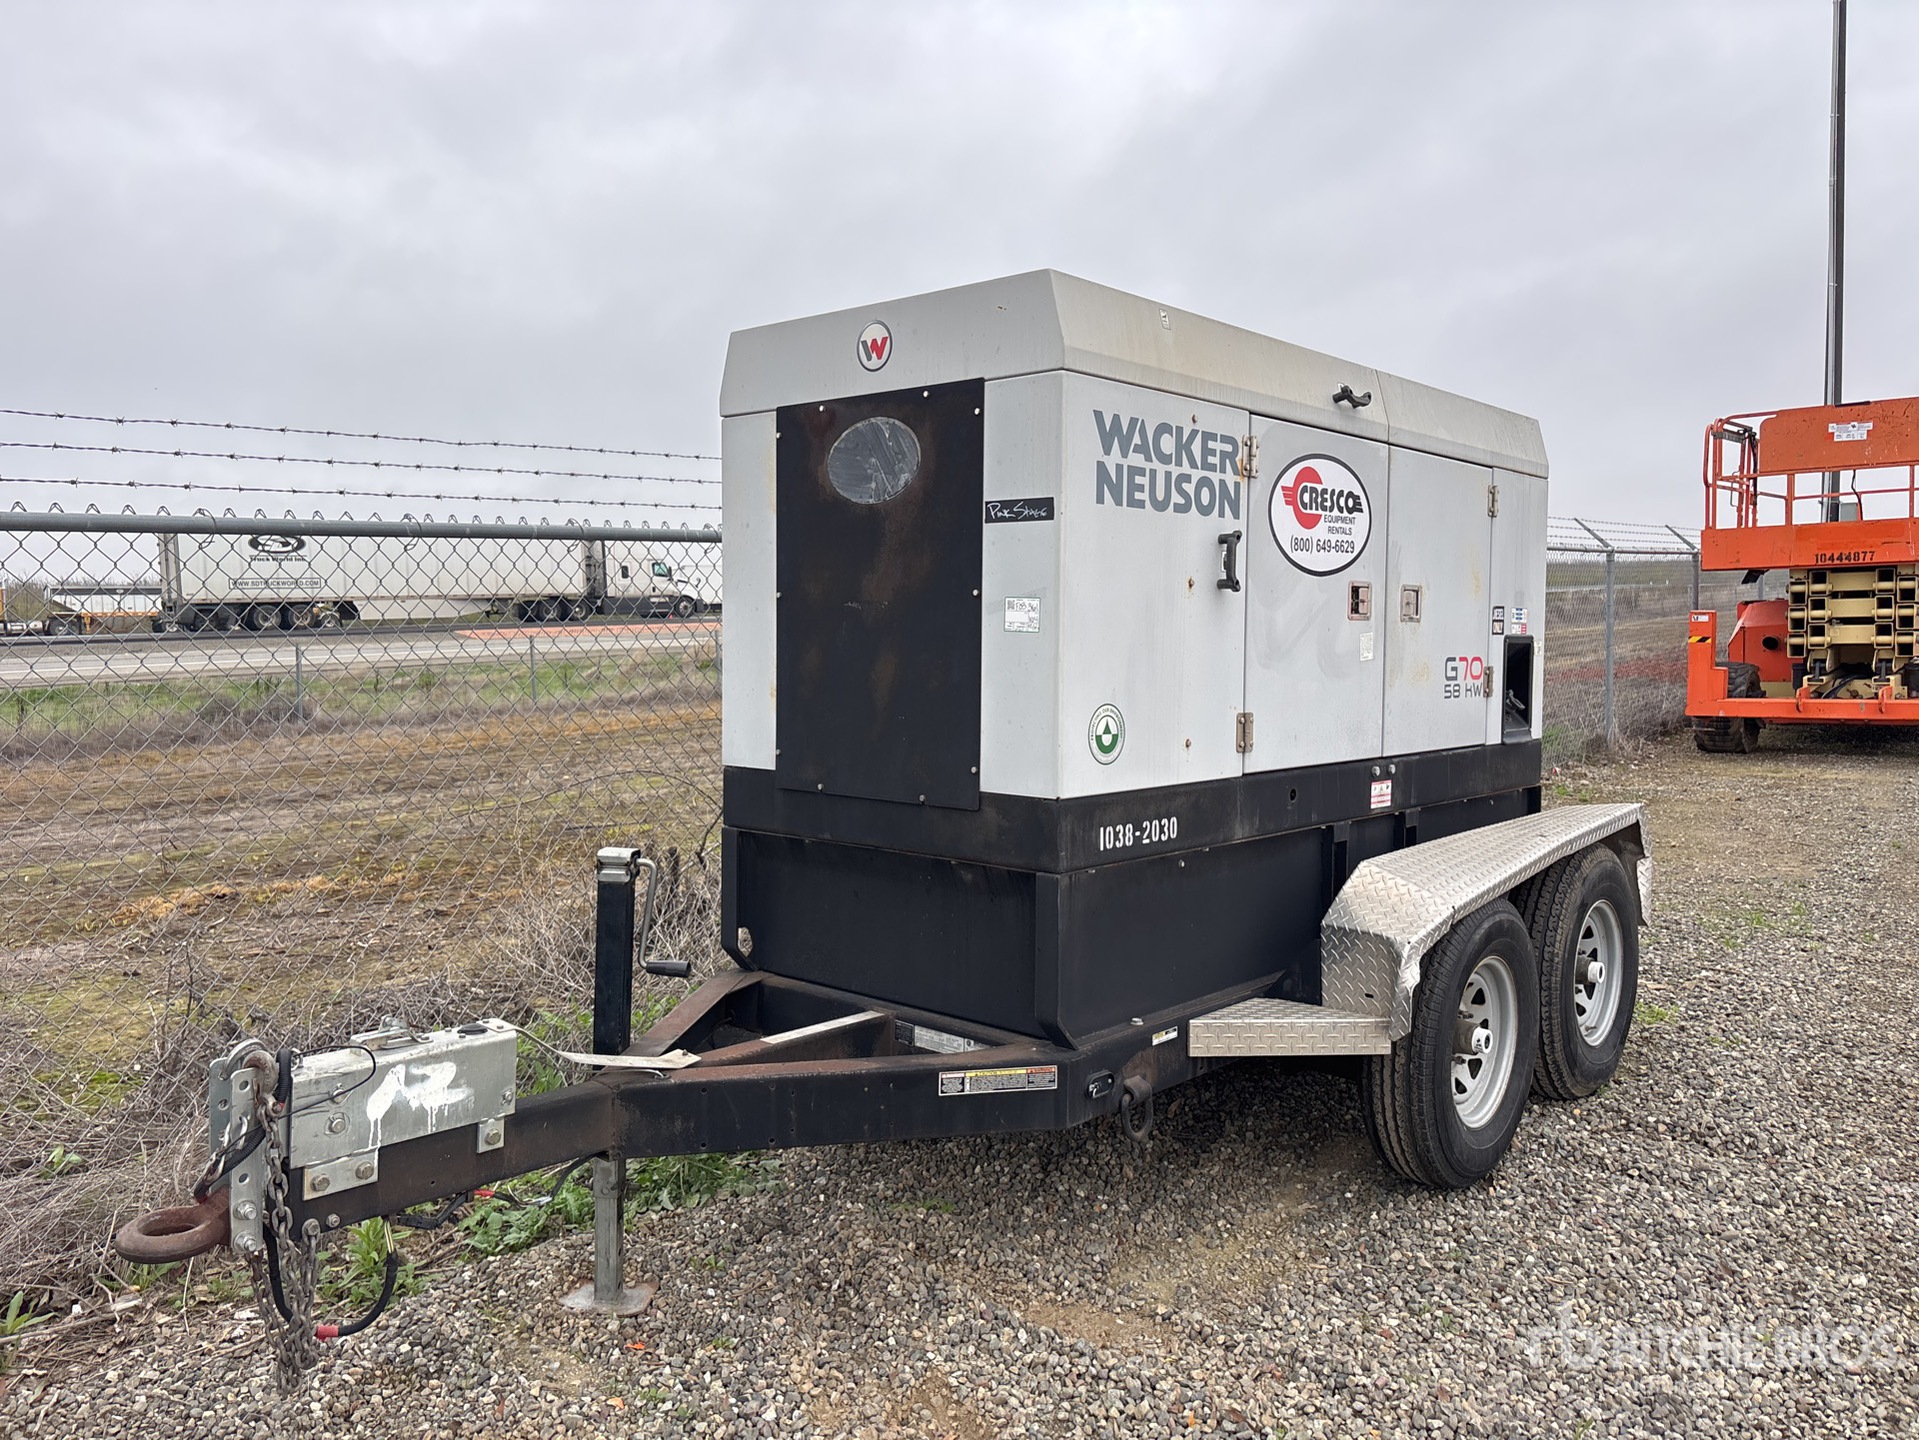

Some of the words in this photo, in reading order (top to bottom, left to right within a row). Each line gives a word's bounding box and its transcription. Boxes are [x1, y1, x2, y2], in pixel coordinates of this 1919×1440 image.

[1093, 409, 1241, 477] WACKER
[1096, 460, 1241, 520] NEUSON
[1299, 484, 1364, 515] CRESCO
[1323, 514, 1356, 525] EQUIPMENT
[1327, 526, 1352, 536] RENTALS
[1290, 535, 1313, 554] (800)
[1315, 538, 1355, 554] 649-6629
[1815, 551, 1875, 564] 10444877
[1445, 656, 1484, 681] G70
[1443, 683, 1461, 699] 58
[1099, 816, 1178, 852] 1038-2030
